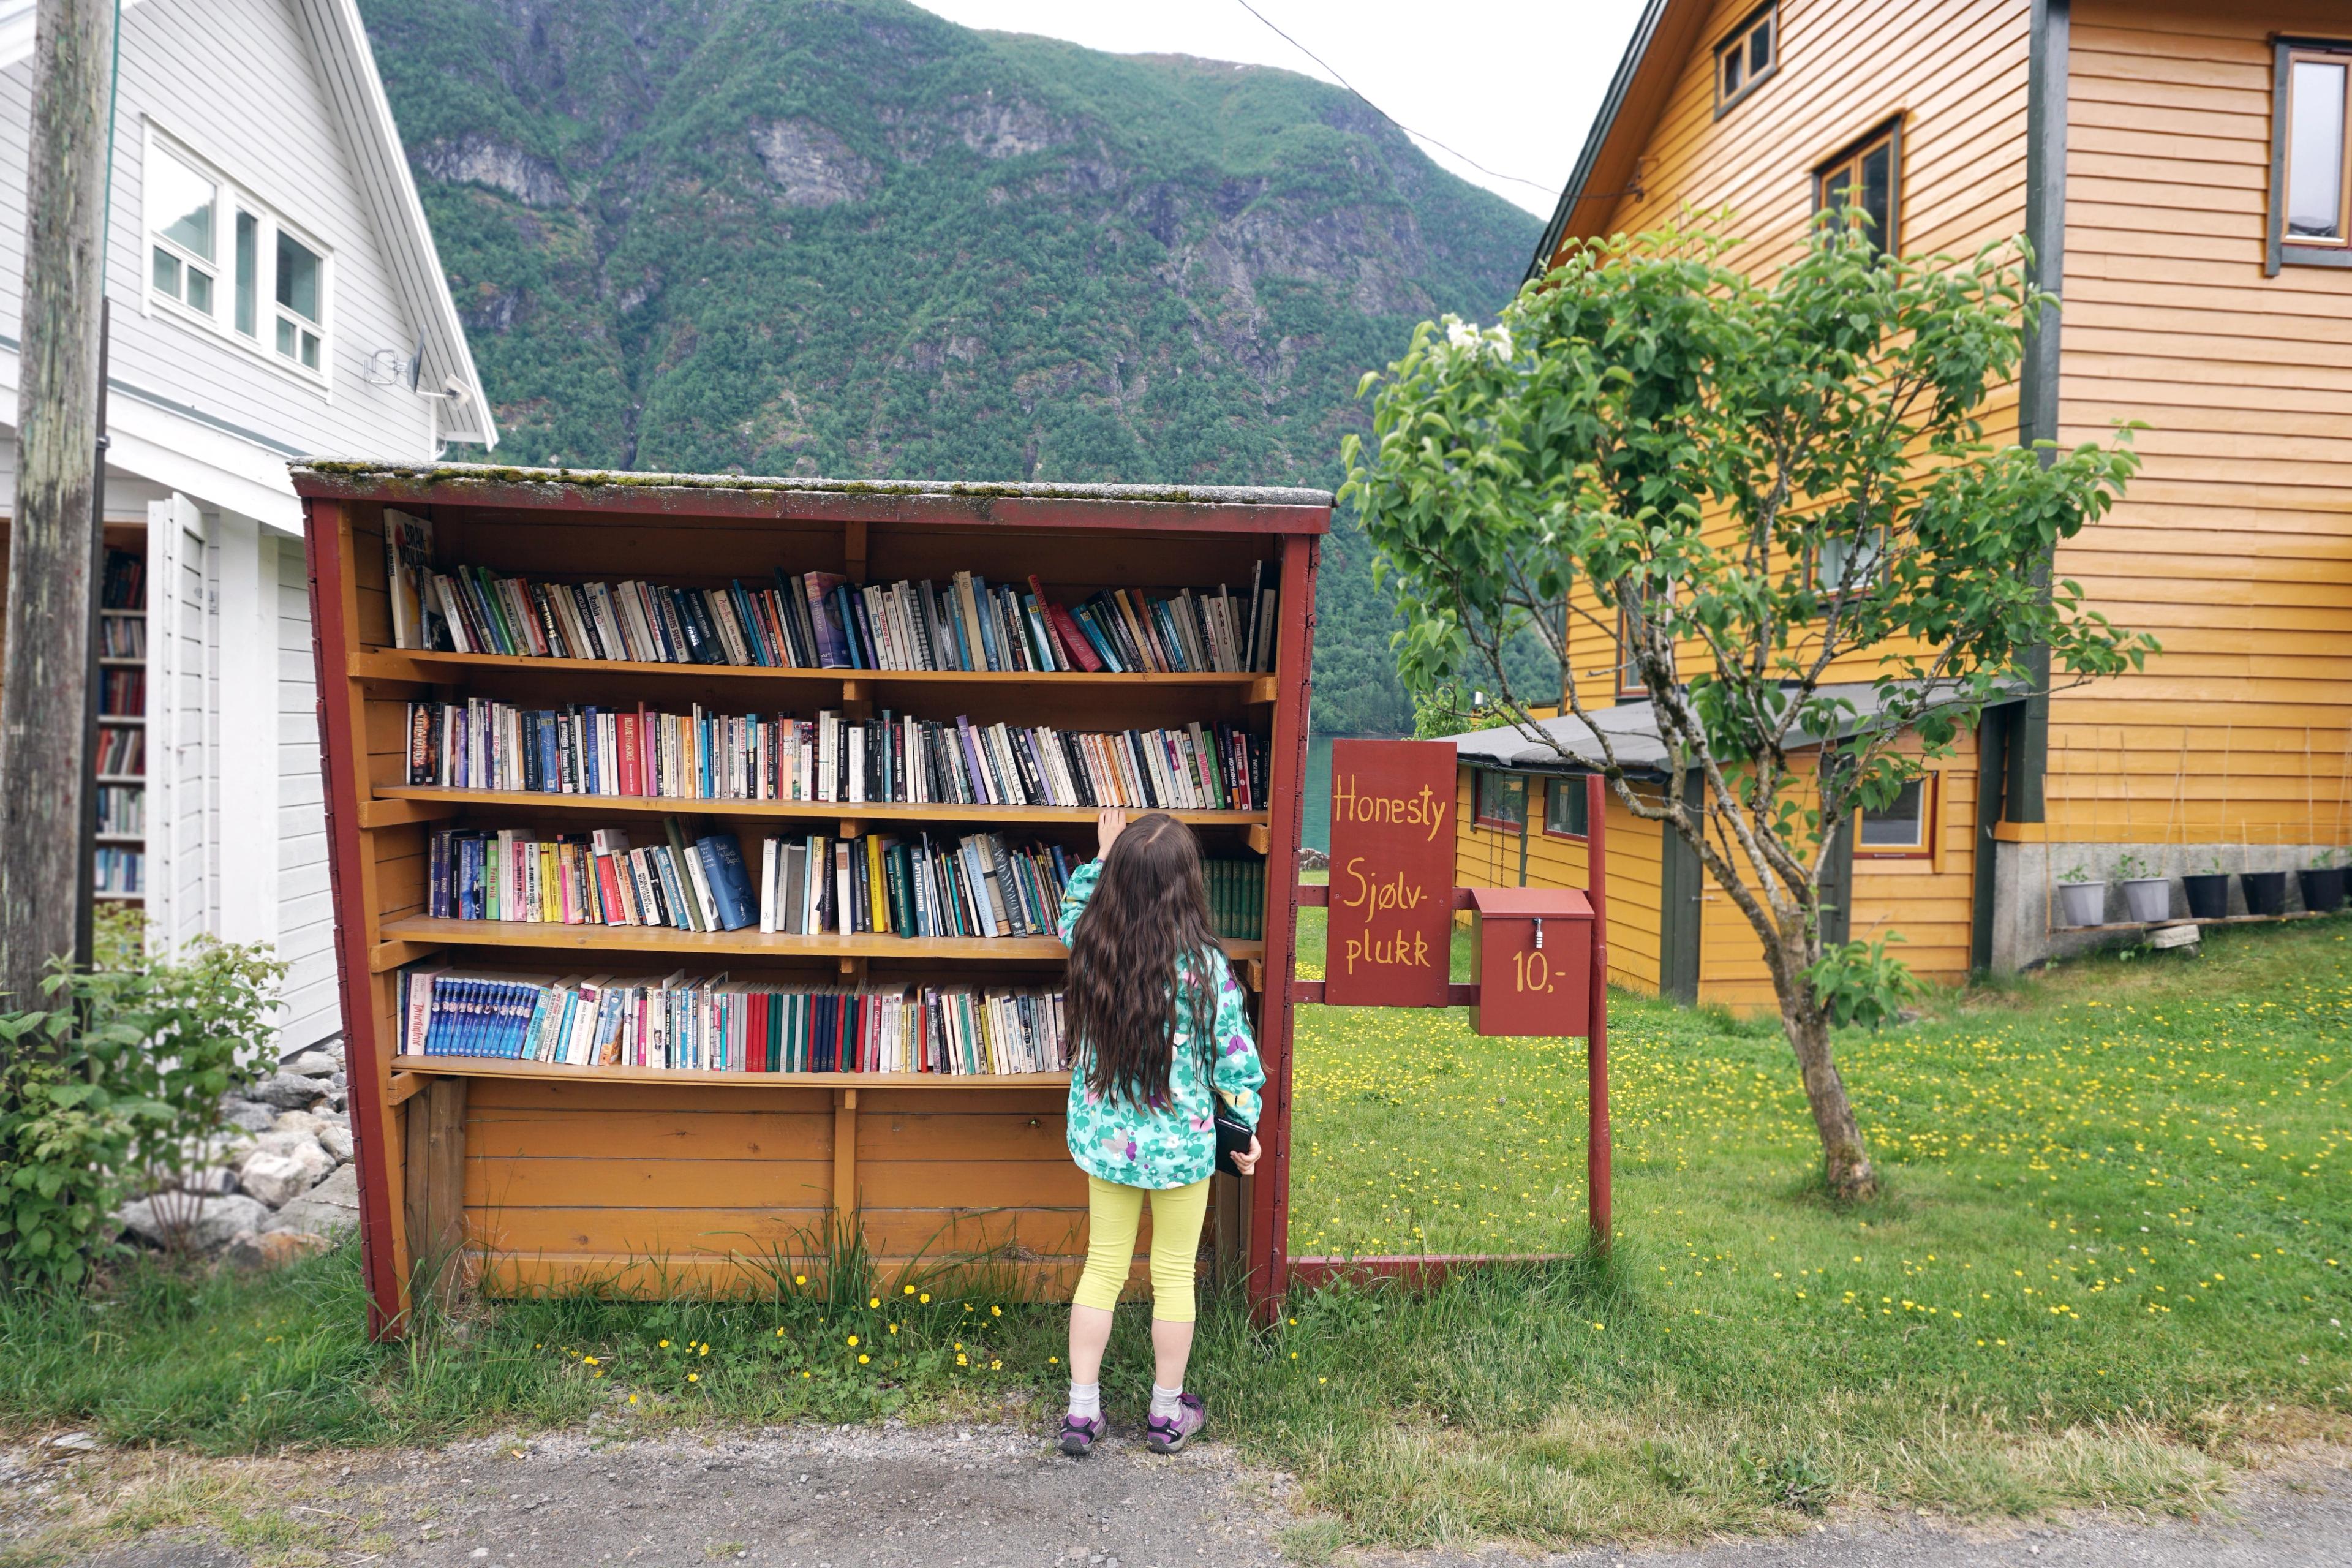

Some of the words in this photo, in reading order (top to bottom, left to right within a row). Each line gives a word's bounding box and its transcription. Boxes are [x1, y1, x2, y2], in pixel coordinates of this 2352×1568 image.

[585, 586, 594, 595] Ian
[589, 595, 600, 616] Rankin
[575, 589, 585, 608] HAROLD
[580, 609, 593, 628] ROBBINS
[664, 600, 677, 628] HEVNENS
[672, 629, 683, 649] SVERD
[694, 606, 703, 617] DEAVER
[723, 611, 731, 623] Perry
[809, 585, 824, 631] Kunsthistorie
[880, 612, 888, 636] STORMENS
[1041, 605, 1055, 632] FREMTID
[1217, 603, 1227, 644] PANIC
[624, 717, 633, 742] ELIZABETH
[625, 744, 634, 761] GEORGE
[996, 748, 1006, 771] OPERASJON
[1008, 758, 1020, 792] FLUKTEN
[1016, 751, 1034, 793] Sammensvergelsen
[1333, 774, 1446, 842] Honesty
[914, 863, 924, 911] AFTENSTJERNEN
[1343, 858, 1428, 922] Sjølv-
[673, 898, 682, 914] stupet
[1346, 929, 1430, 975] plukk
[1513, 949, 1566, 993] 10,-
